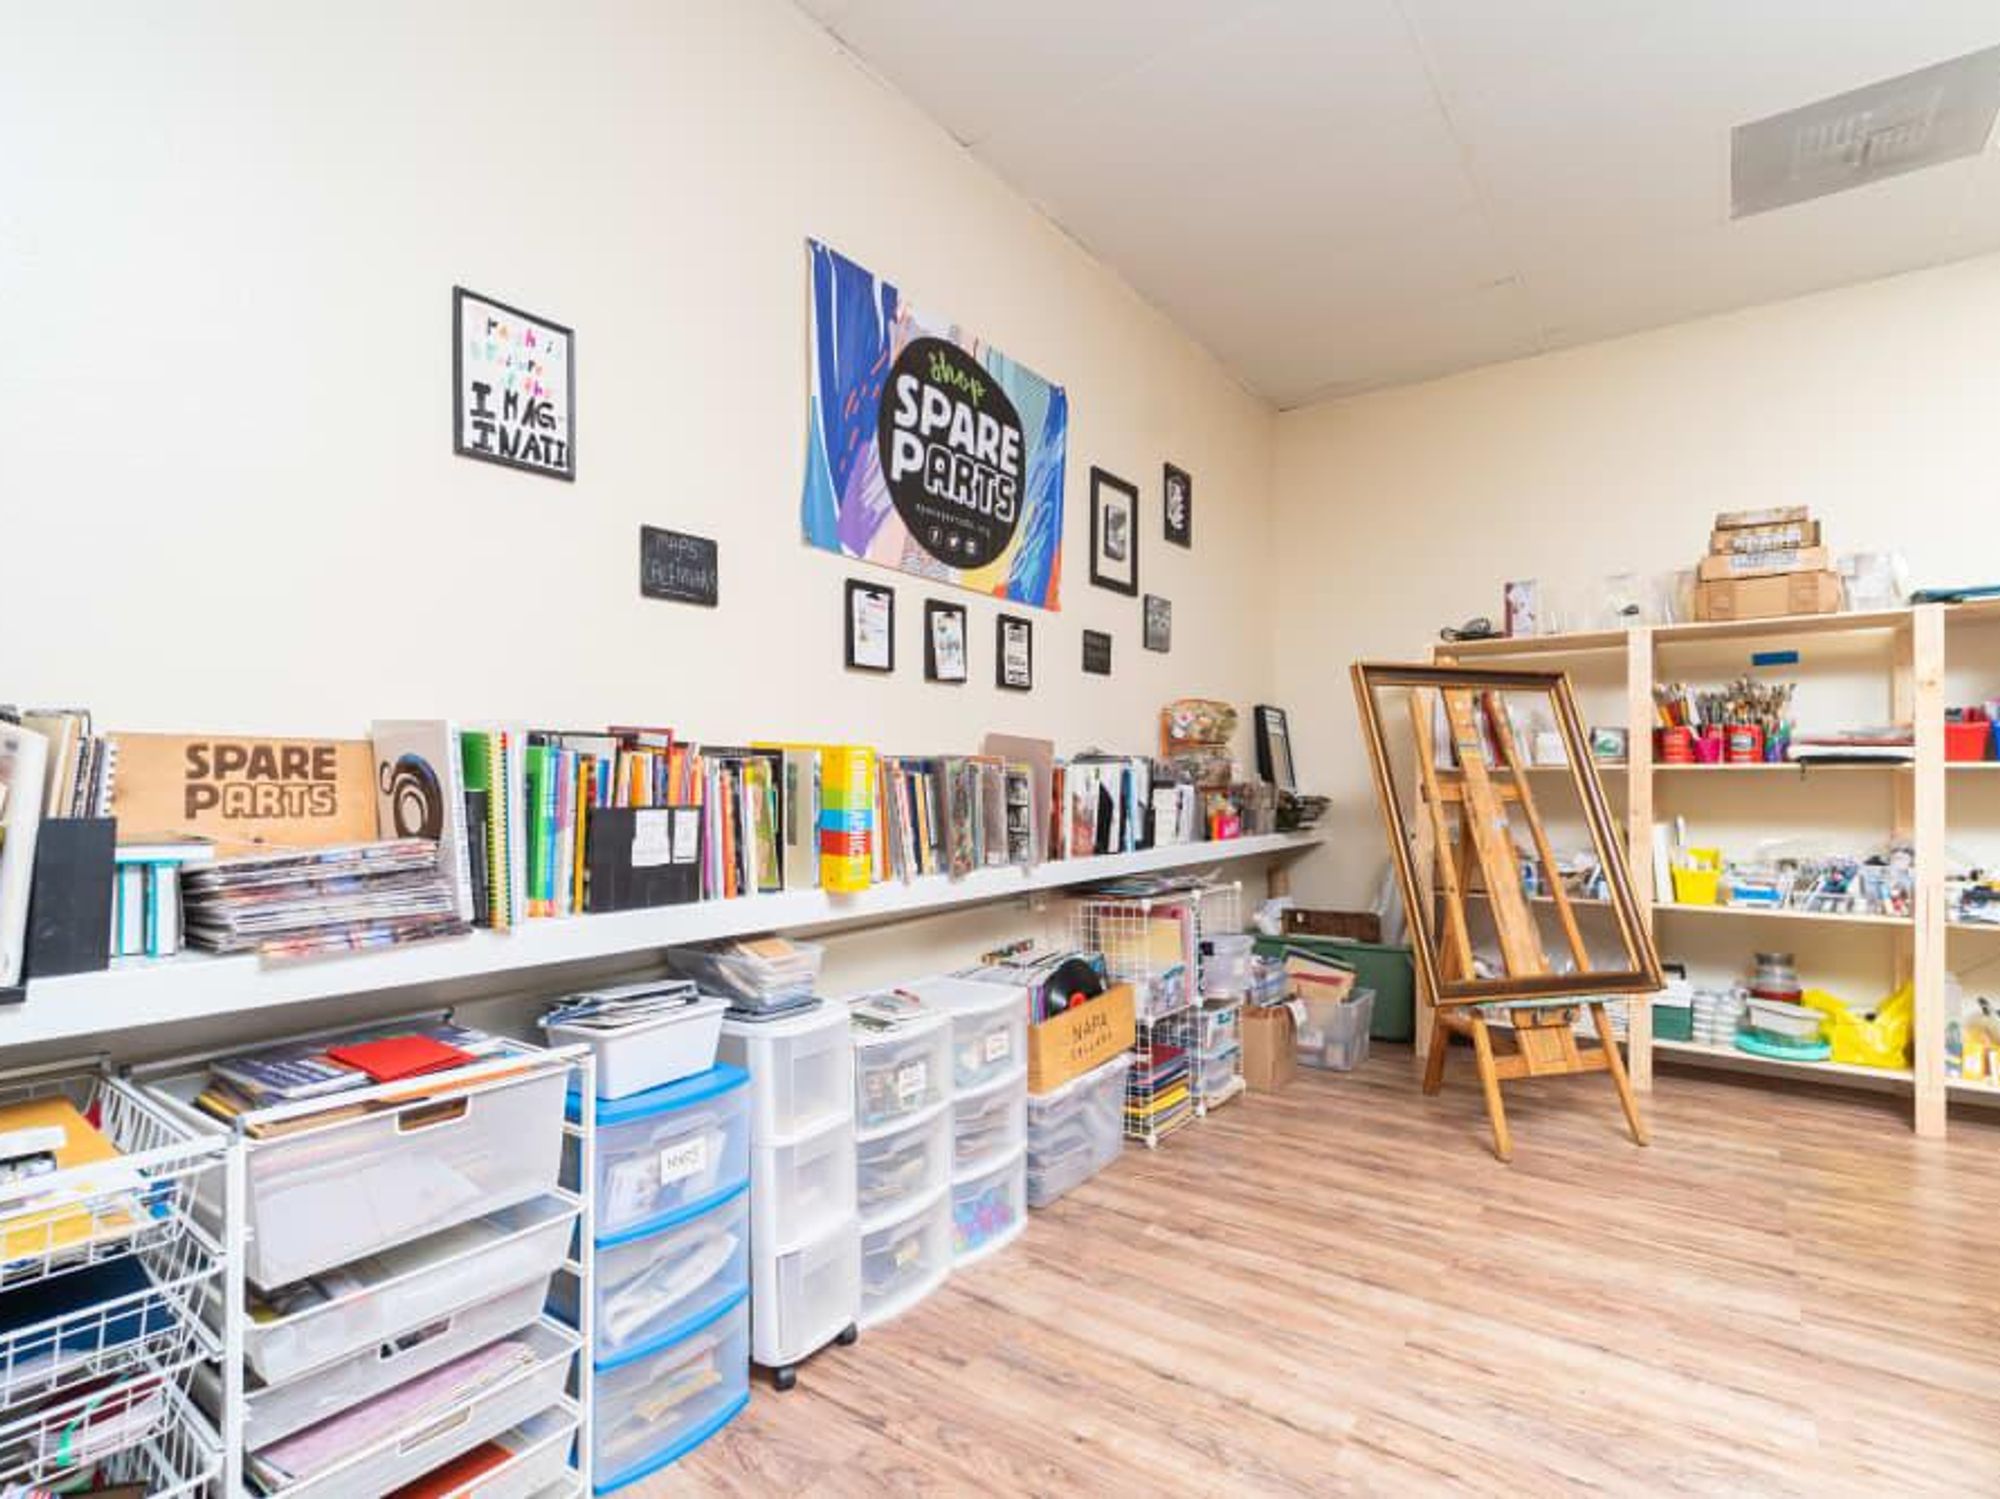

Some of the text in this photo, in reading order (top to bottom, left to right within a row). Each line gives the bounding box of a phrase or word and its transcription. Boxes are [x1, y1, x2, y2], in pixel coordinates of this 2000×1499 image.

[472, 420, 571, 468] INATI
[893, 374, 1019, 477] SPARE
[892, 429, 1018, 522] PARTS
[184, 743, 337, 781] SPARE
[184, 783, 337, 820] PARTS
